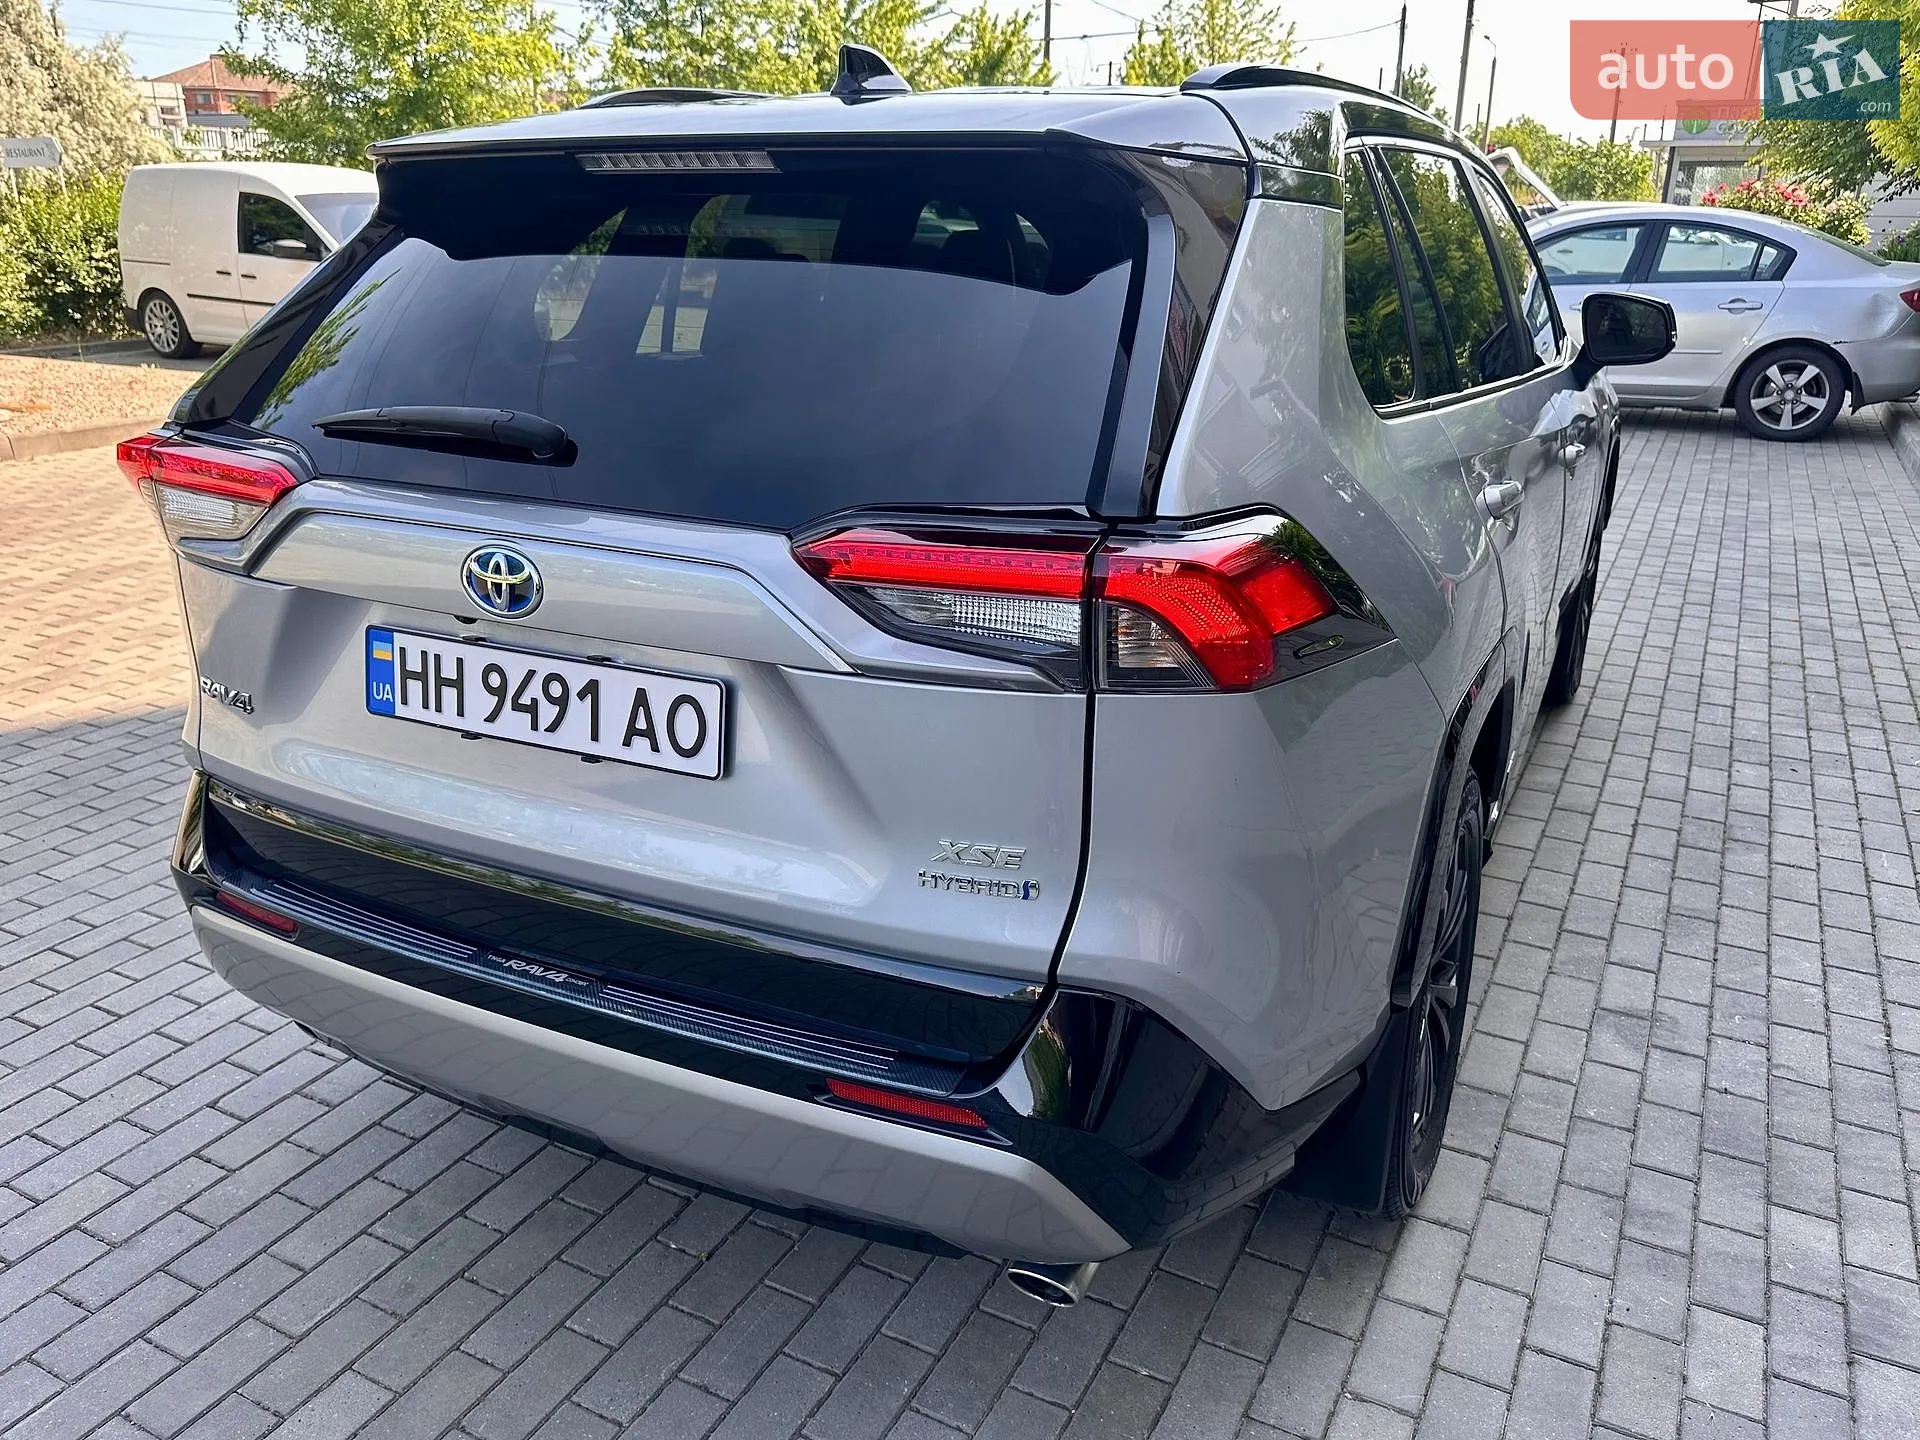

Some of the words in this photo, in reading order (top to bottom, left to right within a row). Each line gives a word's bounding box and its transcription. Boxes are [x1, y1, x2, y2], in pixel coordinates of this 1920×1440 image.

[5, 148, 46, 158] RESTAURANT
[200, 675, 255, 715] RAV4
[373, 681, 394, 702] UA
[399, 646, 465, 718] HH
[481, 662, 599, 742] 9491
[621, 687, 708, 759] AO
[930, 838, 1027, 871] XSE
[916, 868, 1021, 899] HYBRID
[503, 959, 569, 983] RAV4
